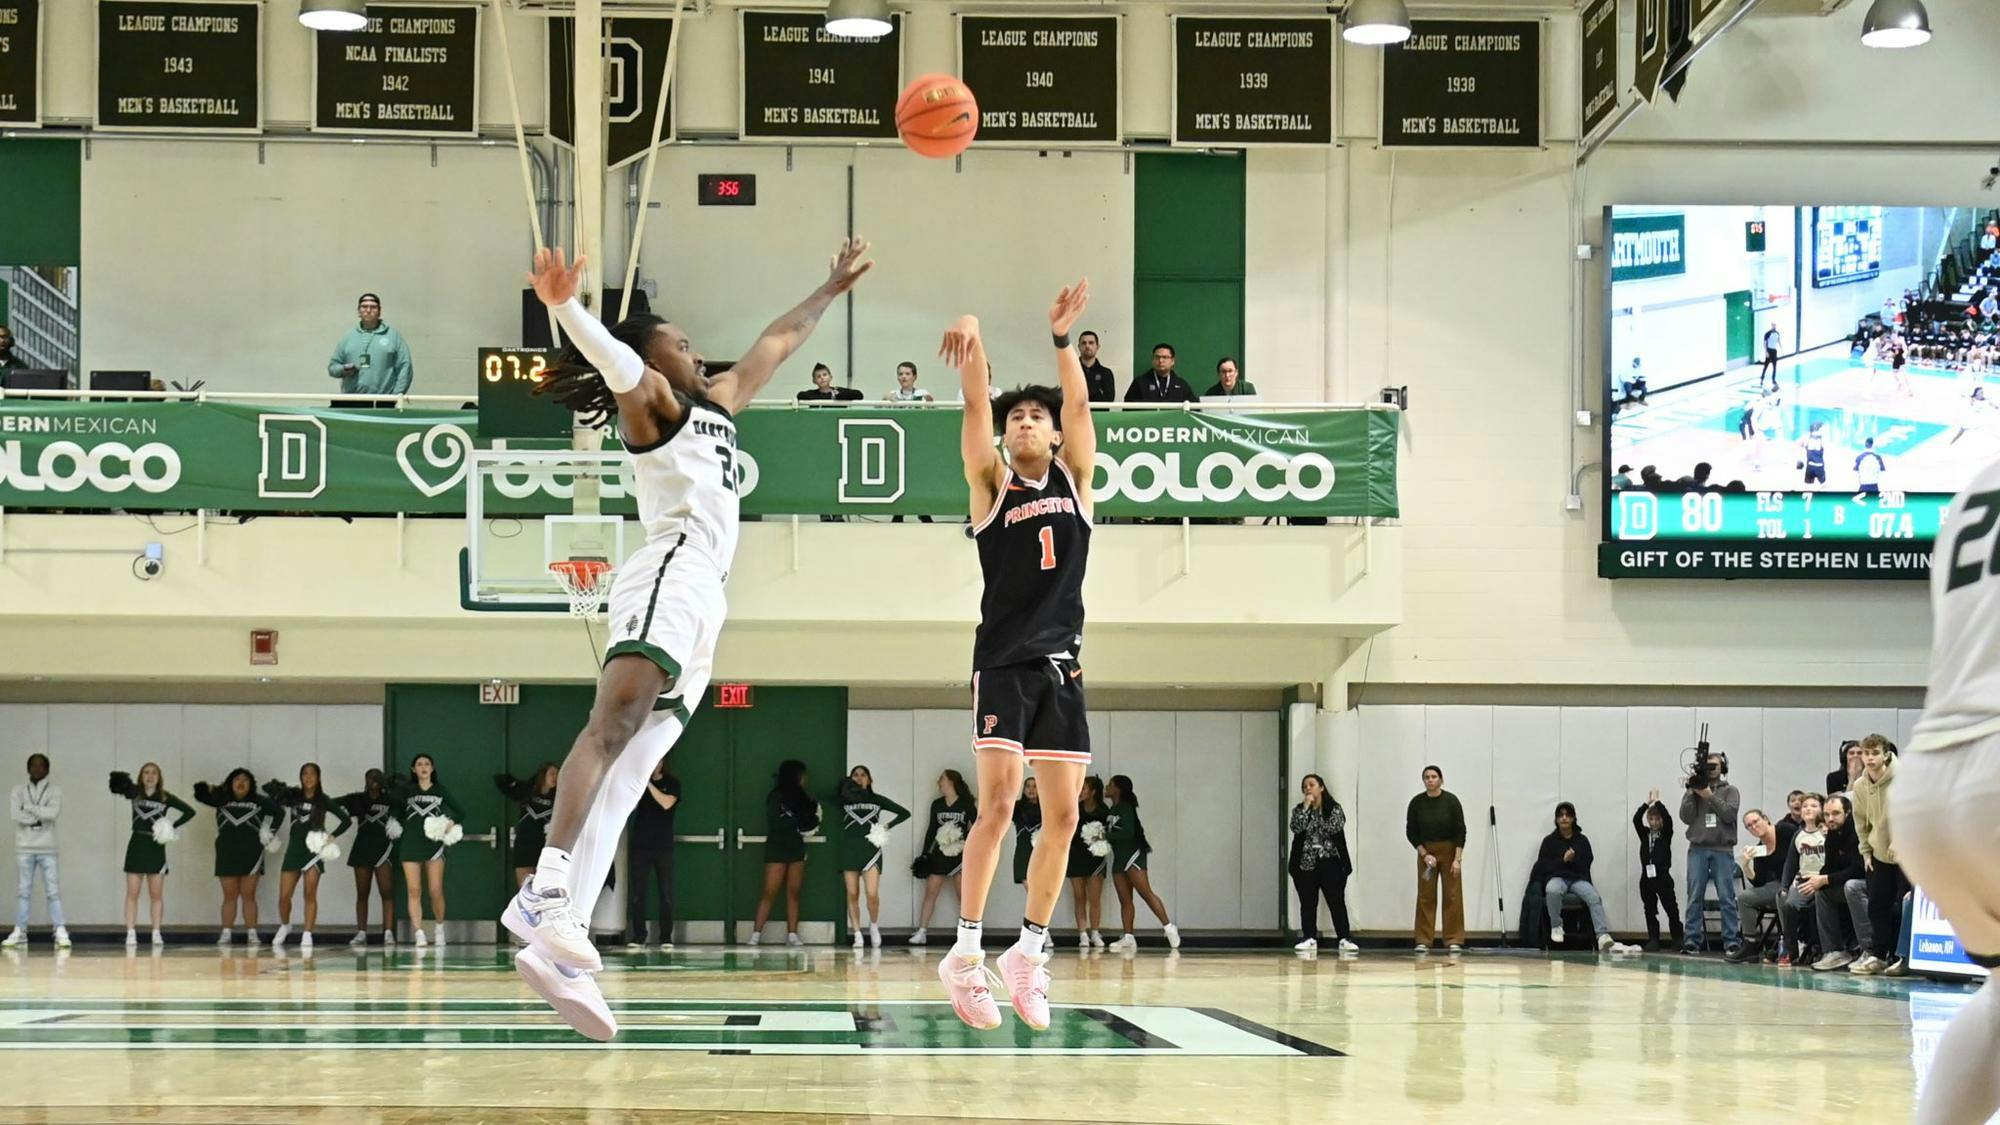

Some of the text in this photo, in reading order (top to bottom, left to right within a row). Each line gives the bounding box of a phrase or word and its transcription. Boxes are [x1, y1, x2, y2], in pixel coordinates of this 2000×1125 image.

[118, 15, 239, 33] LEAGUE CHAMPIONS
[390, 18, 456, 34] CHAMPIONS
[763, 26, 809, 42] LEAGUE
[981, 30, 1098, 47] LEAGUE CHAMPIONS
[1195, 31, 1314, 48] LEAGUE CHAMPIONS
[1402, 34, 1521, 51] LEAGUE CHAMPIONS
[345, 45, 447, 63] NCAA FINALISTS
[164, 57, 194, 74] 1943
[382, 75, 409, 91] 1942
[809, 68, 836, 84] 1941
[1026, 72, 1054, 88] 1940
[1239, 72, 1269, 89] 1939
[1447, 76, 1476, 93] 1938
[118, 97, 239, 116] MEN'S BASKETBALL
[336, 101, 454, 120] MEN'S BASKETBALL
[764, 107, 880, 125] MEN'S BASKETBALL
[982, 111, 1098, 129] MEN'S BASKETBALL
[1195, 112, 1312, 130] MEN'S BASKETBALL
[1402, 116, 1520, 134] MEN'S BASKETBALL
[485, 354, 547, 382] 07.2
[53, 417, 157, 435] MEXICAN
[1106, 427, 1310, 445] MODERN MEXICAN
[258, 413, 327, 498] D
[838, 418, 905, 503] D
[1756, 492, 1814, 512] FLS 7
[1618, 491, 1723, 540] D 80
[1756, 518, 1813, 539] TOL 1
[1038, 525, 1057, 570] 1
[1620, 551, 1669, 568] GIFT
[1675, 551, 1704, 568] OF
[1710, 552, 1753, 569] THE
[1760, 552, 1859, 569] STEPHEN
[483, 684, 516, 702] EXIT
[721, 685, 748, 704] EXIT
[983, 714, 998, 734] P
